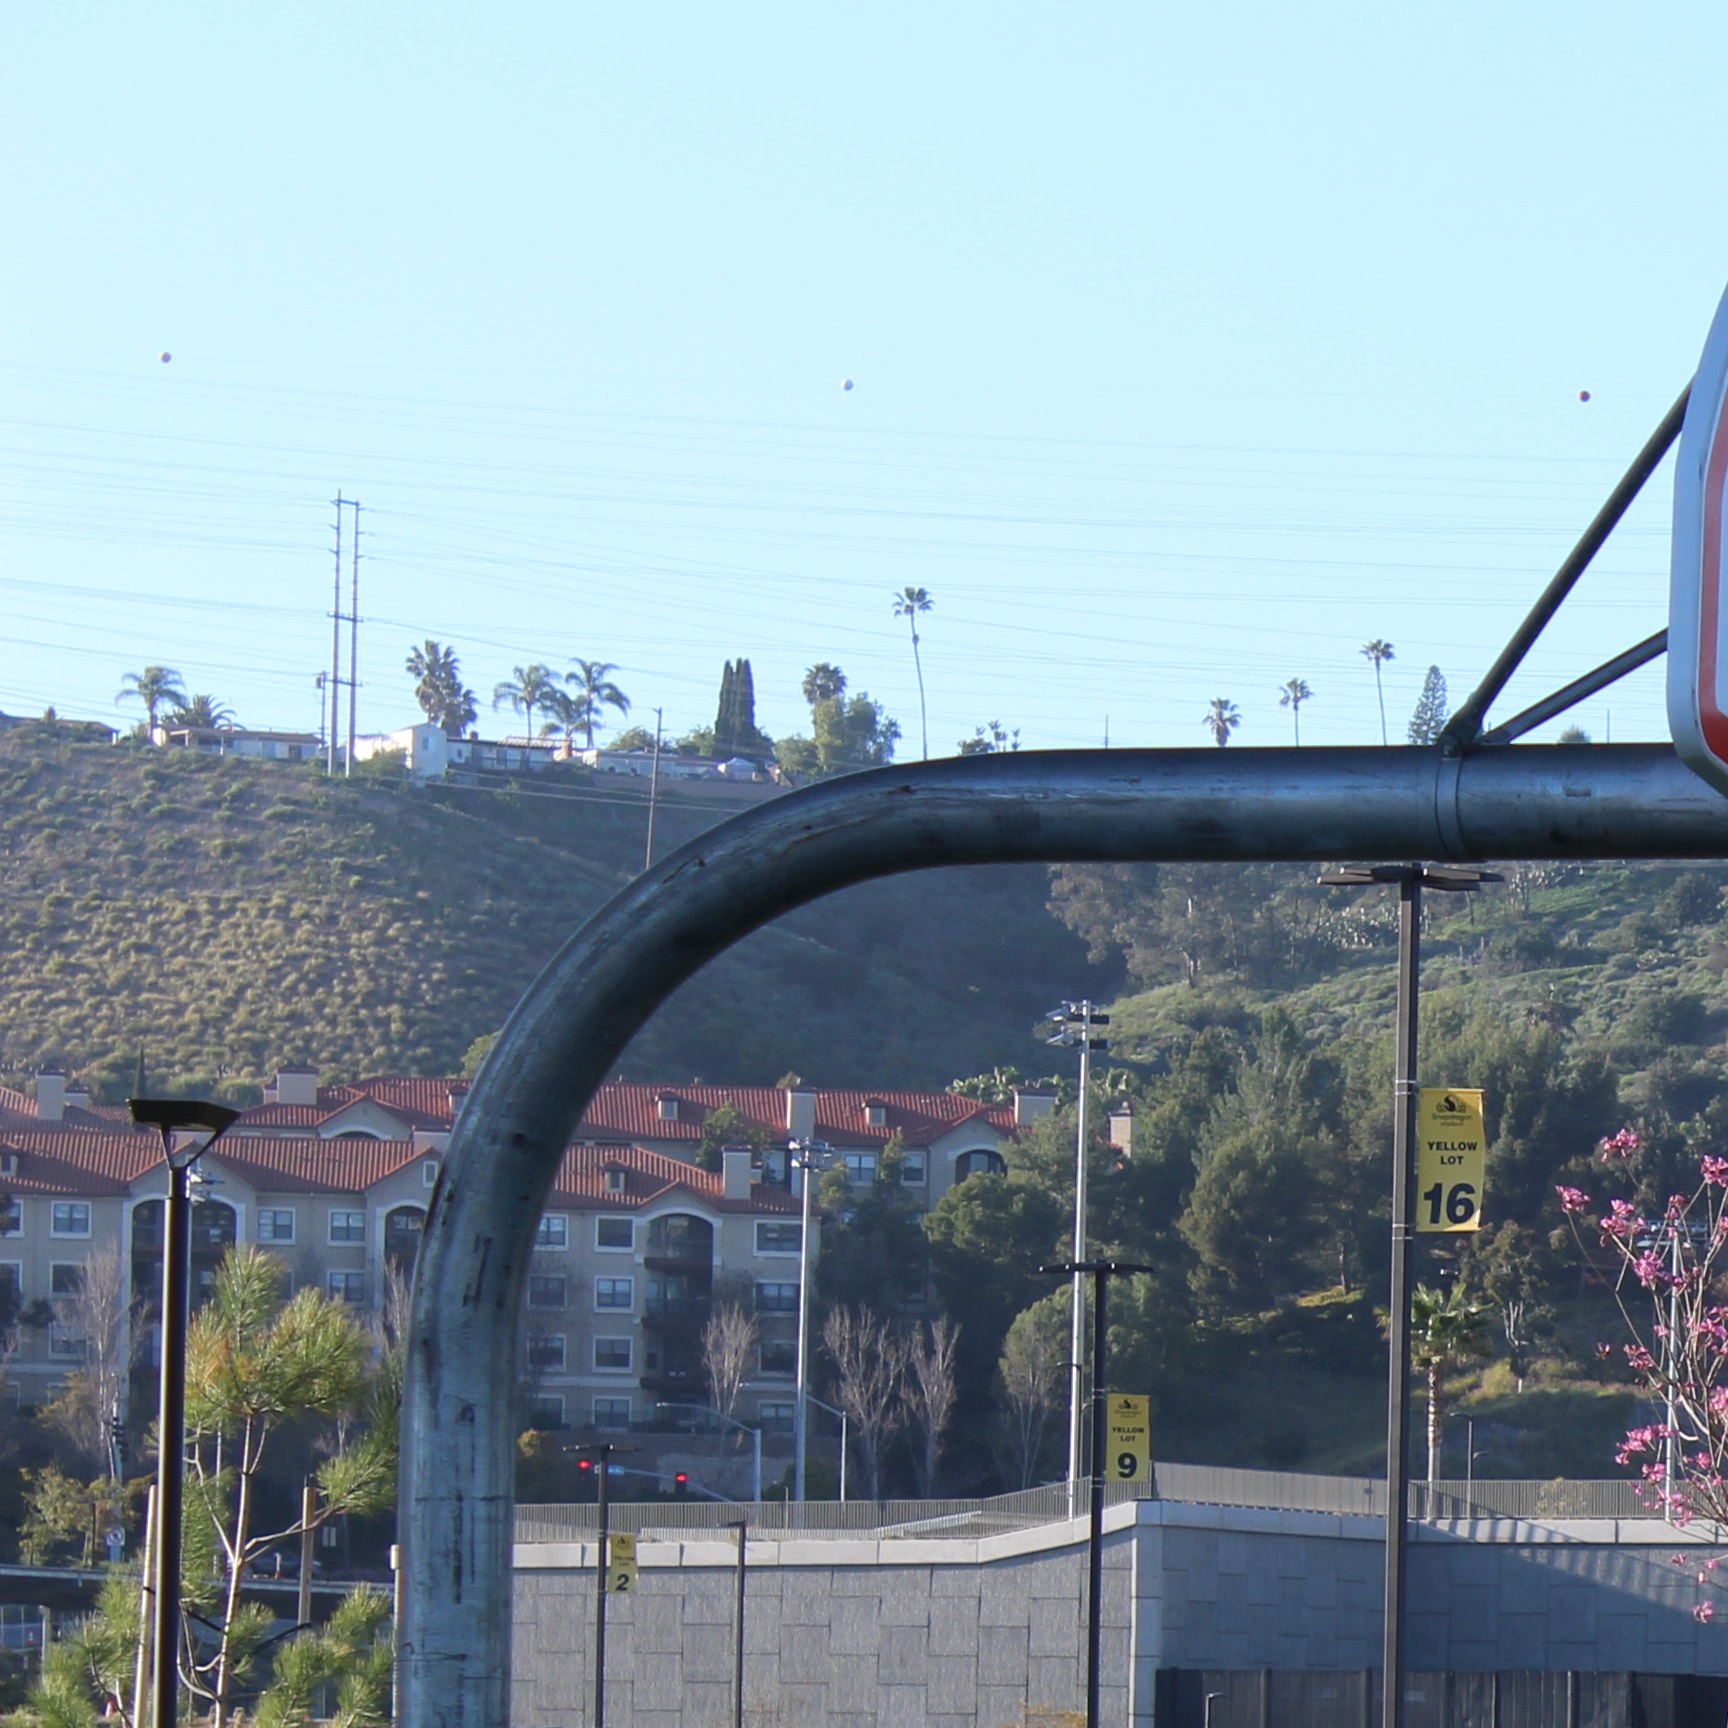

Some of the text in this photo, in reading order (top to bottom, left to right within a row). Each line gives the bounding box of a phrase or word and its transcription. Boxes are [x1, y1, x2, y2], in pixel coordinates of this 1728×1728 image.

[1427, 1141, 1477, 1151] YELLOW
[1440, 1156, 1464, 1165] LOT
[1423, 1182, 1476, 1225] 16
[1117, 1452, 1138, 1479] 9
[615, 1573, 629, 1591] 2
